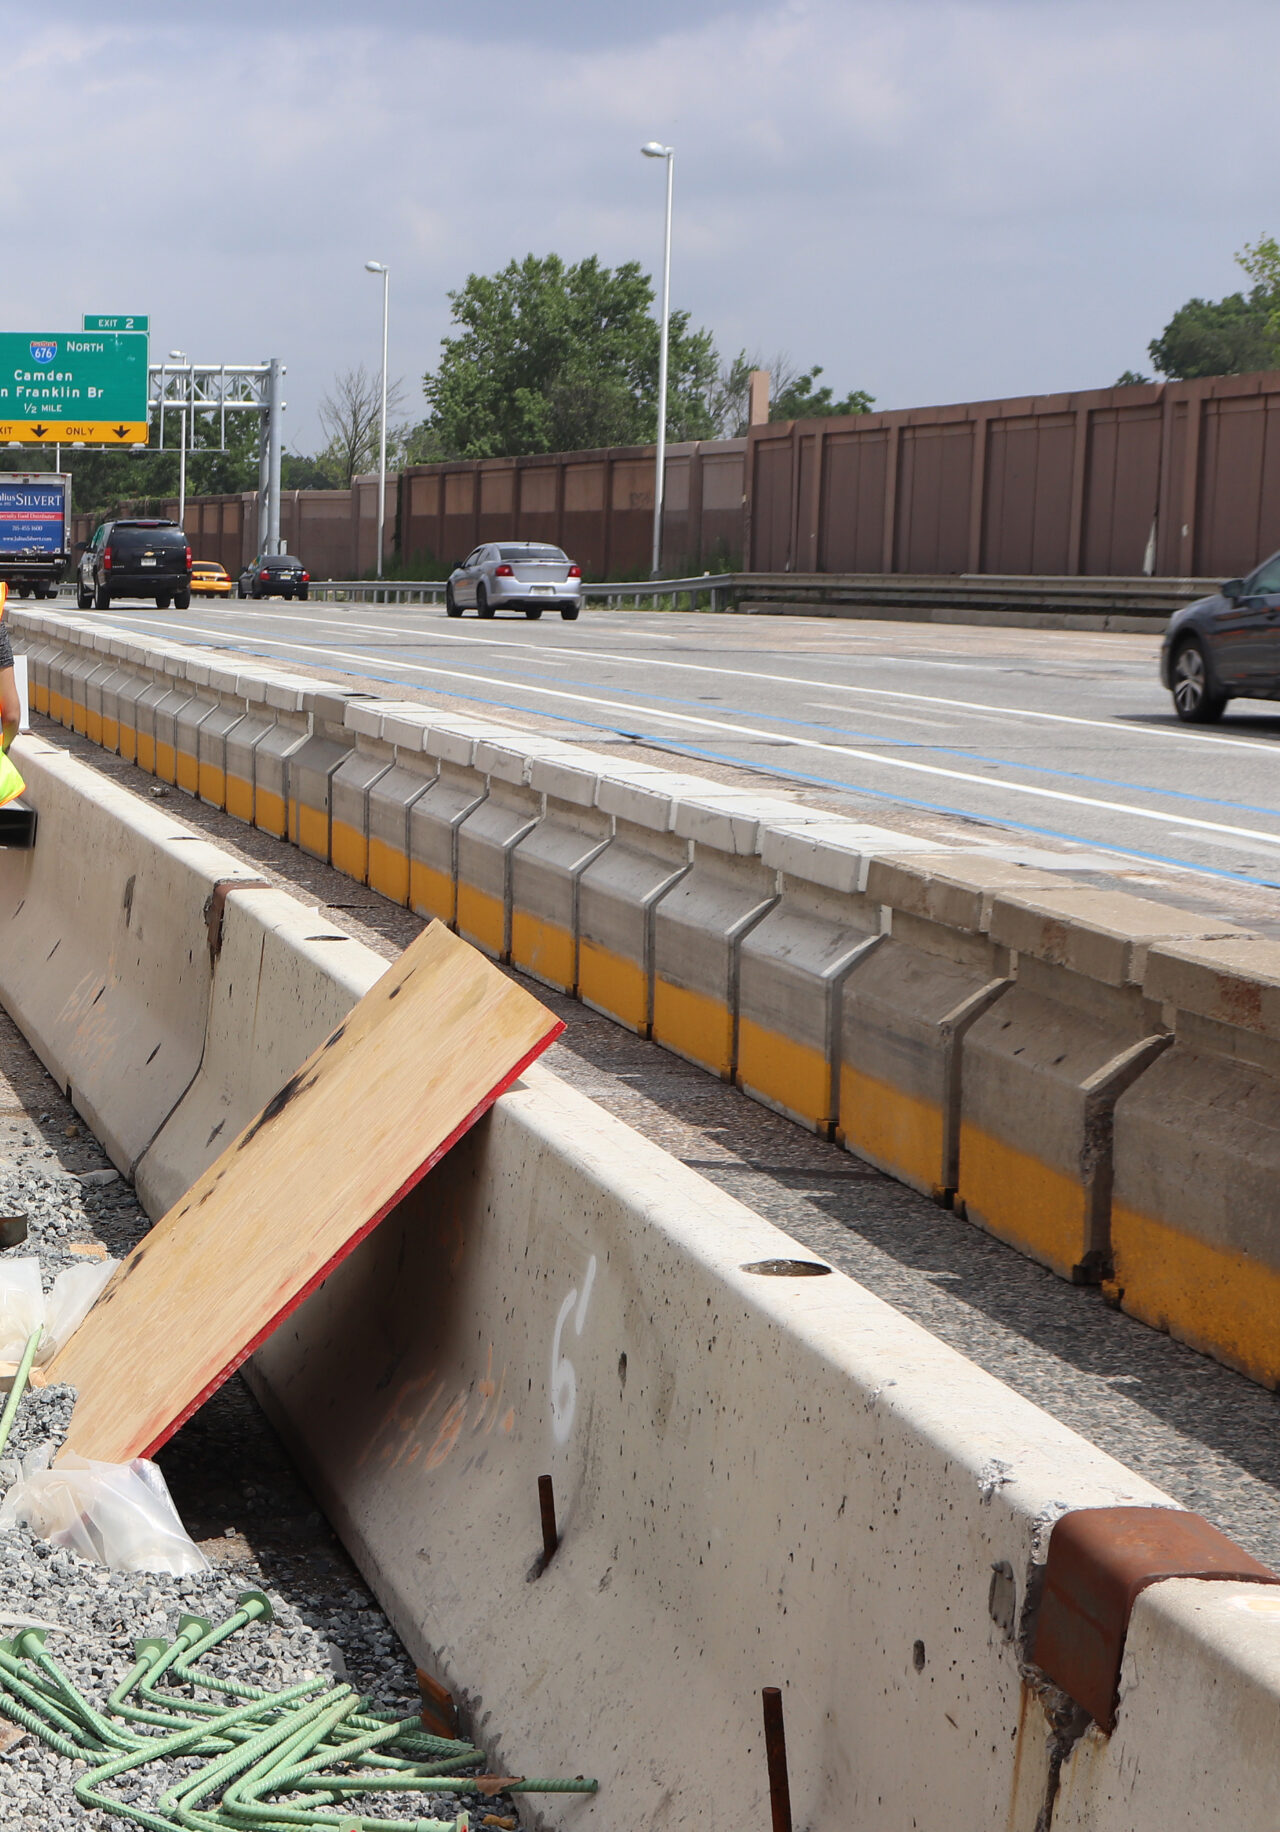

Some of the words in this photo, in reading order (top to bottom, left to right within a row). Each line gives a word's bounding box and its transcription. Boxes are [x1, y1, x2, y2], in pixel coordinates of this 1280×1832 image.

[98, 319, 118, 327] EXIT
[125, 318, 134, 329] 2
[34, 348, 52, 359] 676
[66, 341, 104, 352] NORTH
[14, 369, 73, 381] Camden
[16, 386, 80, 398] Franklin
[87, 387, 104, 398] Br
[41, 404, 63, 413] MILE
[65, 427, 94, 436] ONLY
[15, 493, 62, 506] SILVERT
